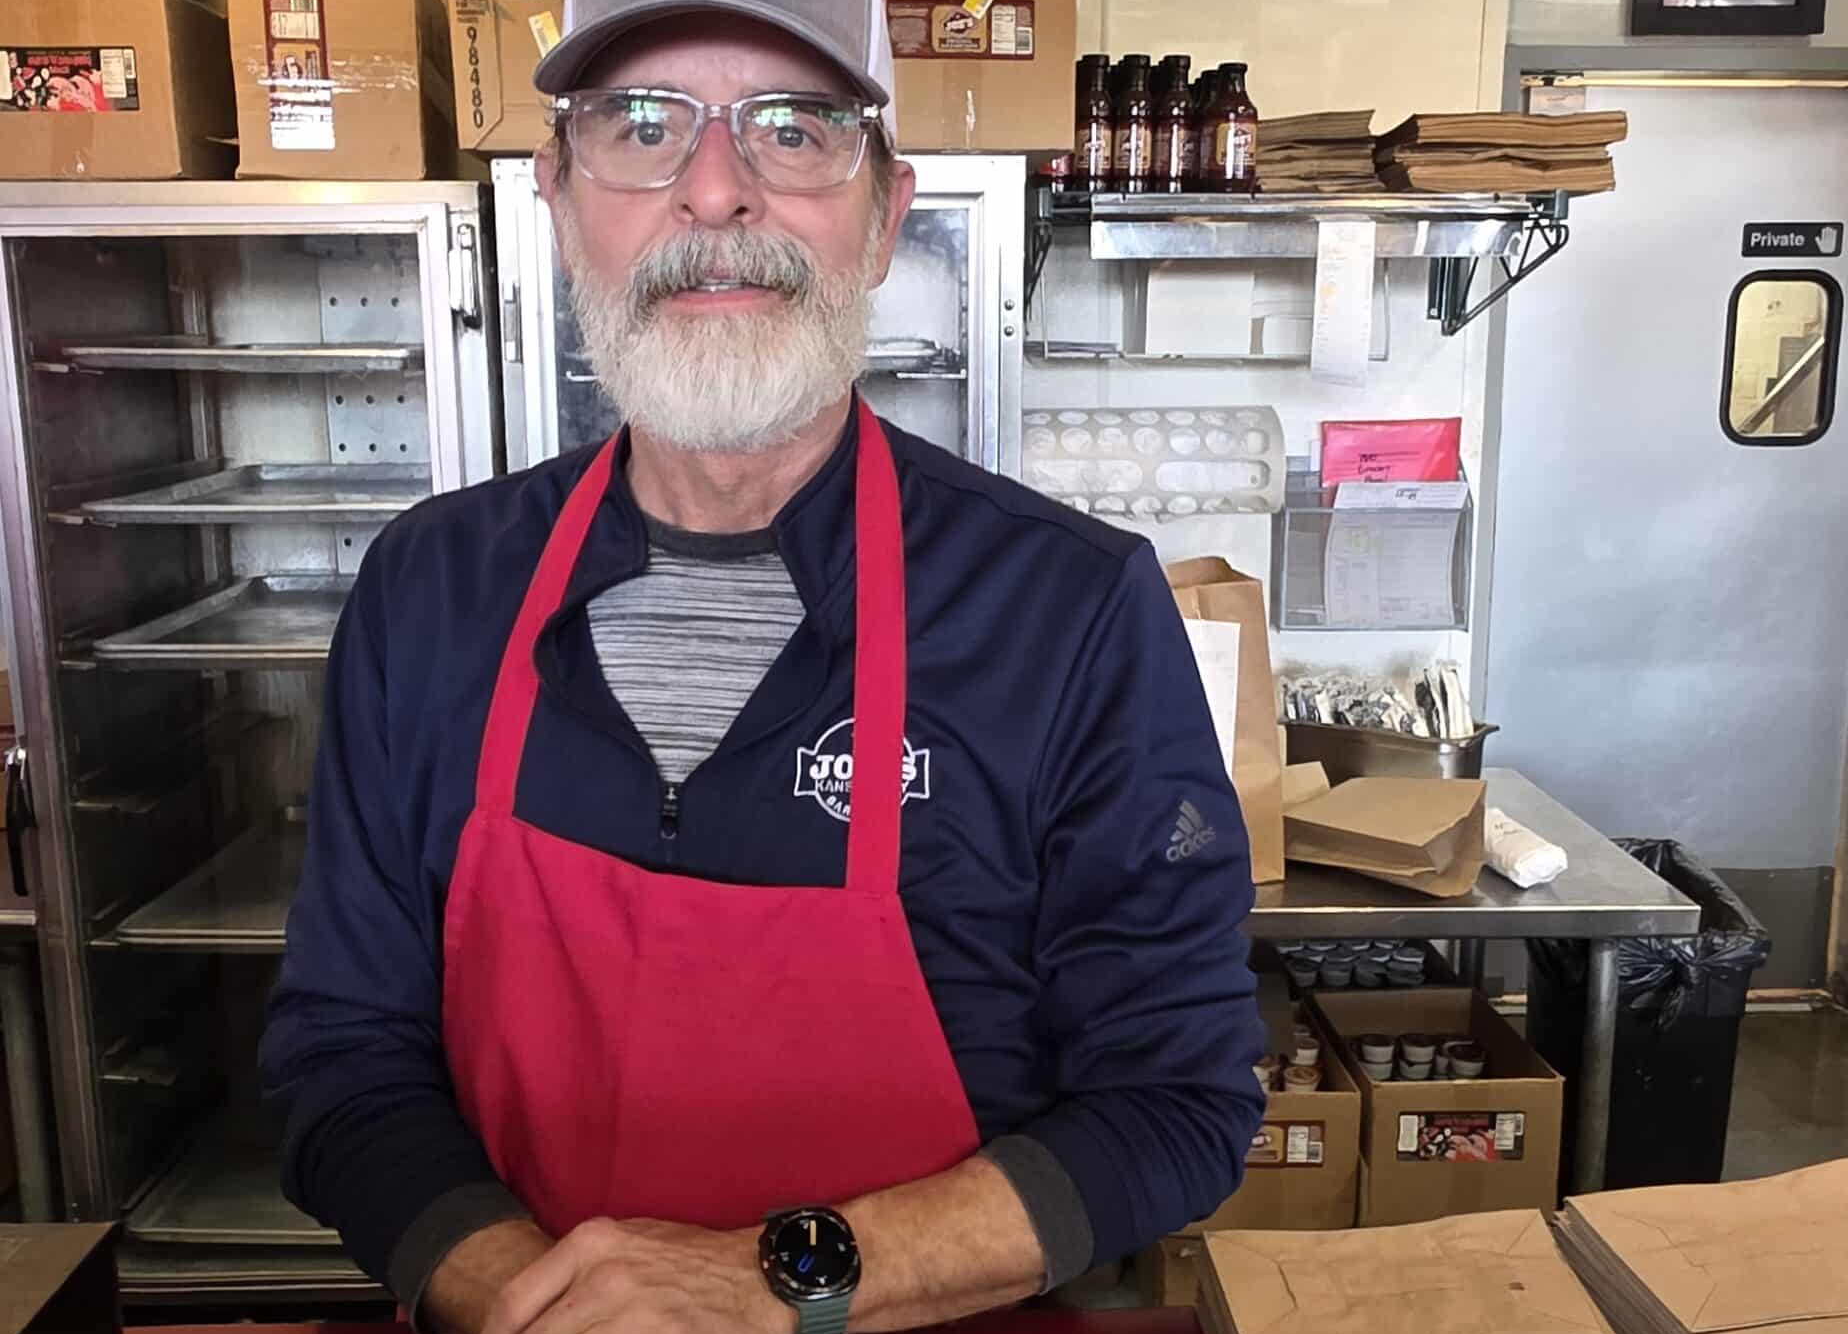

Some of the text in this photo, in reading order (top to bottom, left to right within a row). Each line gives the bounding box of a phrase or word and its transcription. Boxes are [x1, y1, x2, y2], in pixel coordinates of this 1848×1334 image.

[467, 27, 483, 128] 98480
[1751, 231, 1805, 247] Private
[1166, 827, 1216, 862] adidas
